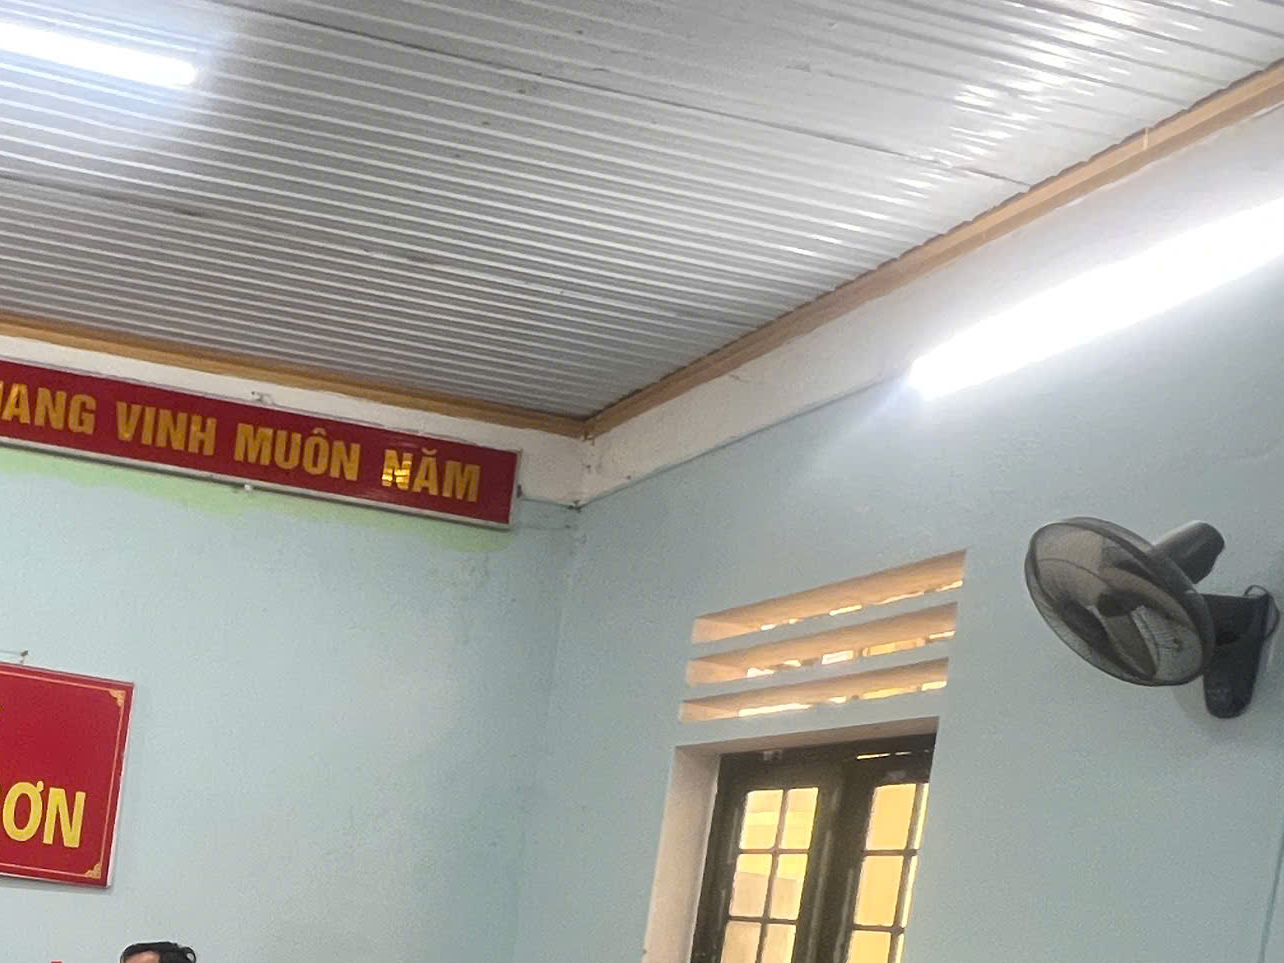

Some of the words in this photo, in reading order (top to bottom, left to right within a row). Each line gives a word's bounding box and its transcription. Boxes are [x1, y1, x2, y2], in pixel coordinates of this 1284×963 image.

[117, 402, 216, 457] VINH
[235, 425, 361, 482] MUÔN
[382, 446, 482, 502] NĂM
